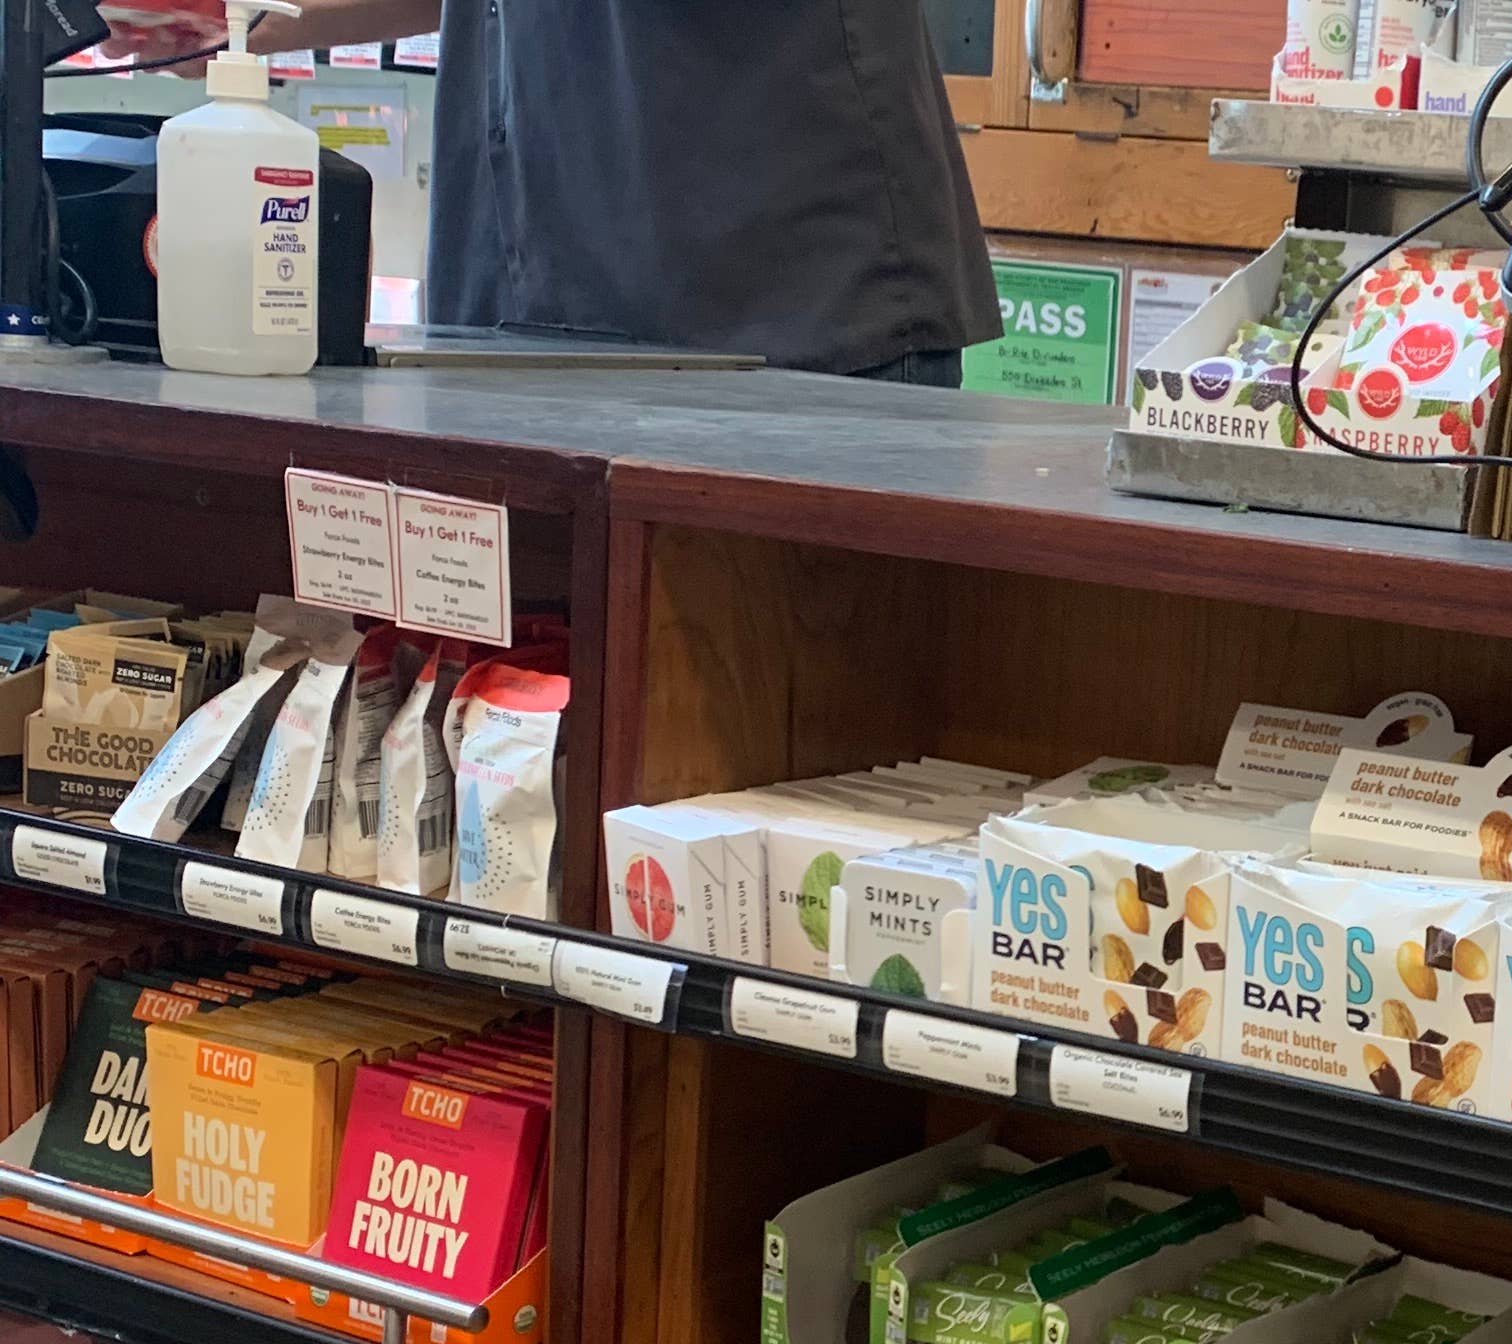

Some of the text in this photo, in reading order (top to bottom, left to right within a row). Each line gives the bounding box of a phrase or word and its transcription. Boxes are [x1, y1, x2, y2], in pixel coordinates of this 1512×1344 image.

[1425, 91, 1466, 113] hand
[264, 242, 306, 253] SANITIZER
[273, 233, 298, 242] HAND
[1000, 300, 1086, 338] PASS
[1147, 407, 1269, 440] BLACKBERRY
[1314, 428, 1440, 456] RASPBERRY
[297, 499, 318, 517] Buy
[329, 508, 348, 520] Get
[359, 514, 382, 527] Free
[405, 521, 425, 539] Buy
[437, 528, 457, 541] Get
[469, 535, 493, 549] Free
[343, 552, 366, 567] Energy
[442, 574, 466, 588] Energy
[116, 667, 172, 684] ZERO SUGAR
[52, 726, 154, 754] THE GOOD
[47, 745, 153, 774] CHOCOLAT
[1357, 758, 1459, 787] peanut butter
[1350, 776, 1461, 808] dark chocolate
[864, 885, 941, 914] SIMPLY
[870, 911, 933, 936] MINTS
[992, 931, 1066, 971] BAR
[1243, 983, 1322, 1025] BAR
[199, 1046, 255, 1083] TCHO
[409, 1084, 464, 1124] TCHO
[183, 1111, 267, 1175] HOLY
[175, 1157, 276, 1229] FUDGE
[367, 1151, 469, 1225] BORN
[348, 1199, 469, 1280] FRUITY
